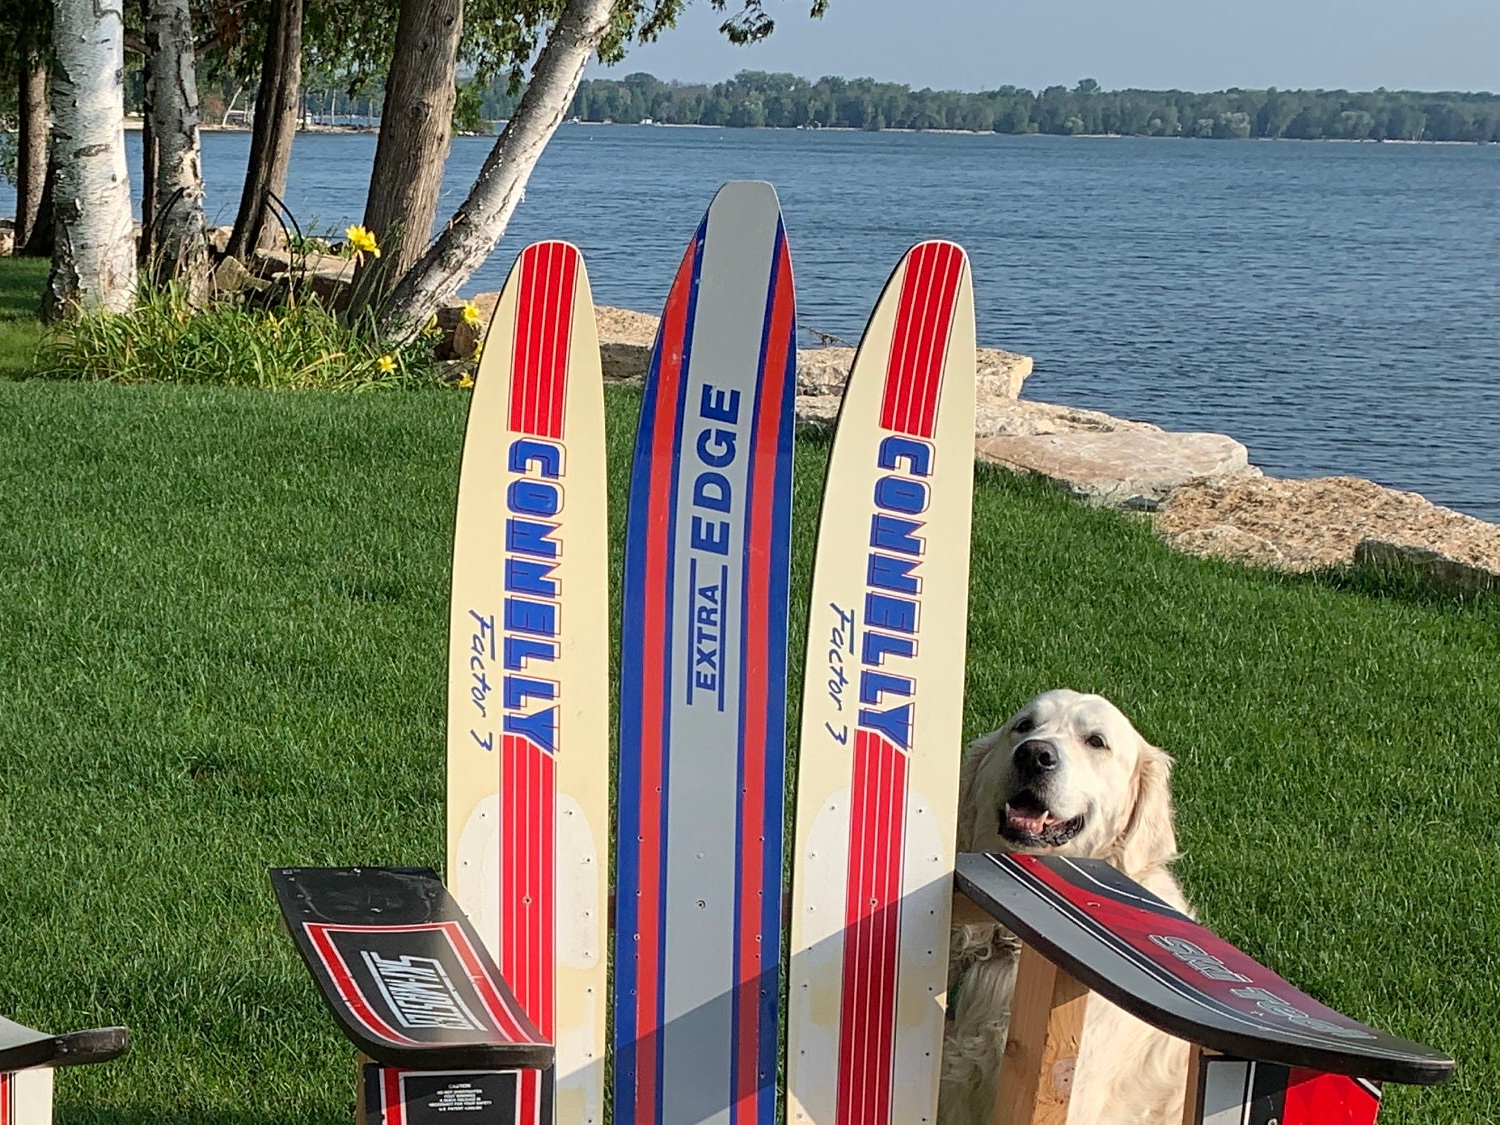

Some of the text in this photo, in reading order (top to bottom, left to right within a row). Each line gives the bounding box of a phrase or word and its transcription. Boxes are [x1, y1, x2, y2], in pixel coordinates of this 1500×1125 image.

[468, 610, 495, 718] Factor
[502, 436, 567, 754] CONNELLY
[691, 383, 741, 692] EXTRA EDGE
[828, 602, 854, 711] Factor
[858, 435, 936, 752] CONNELLY
